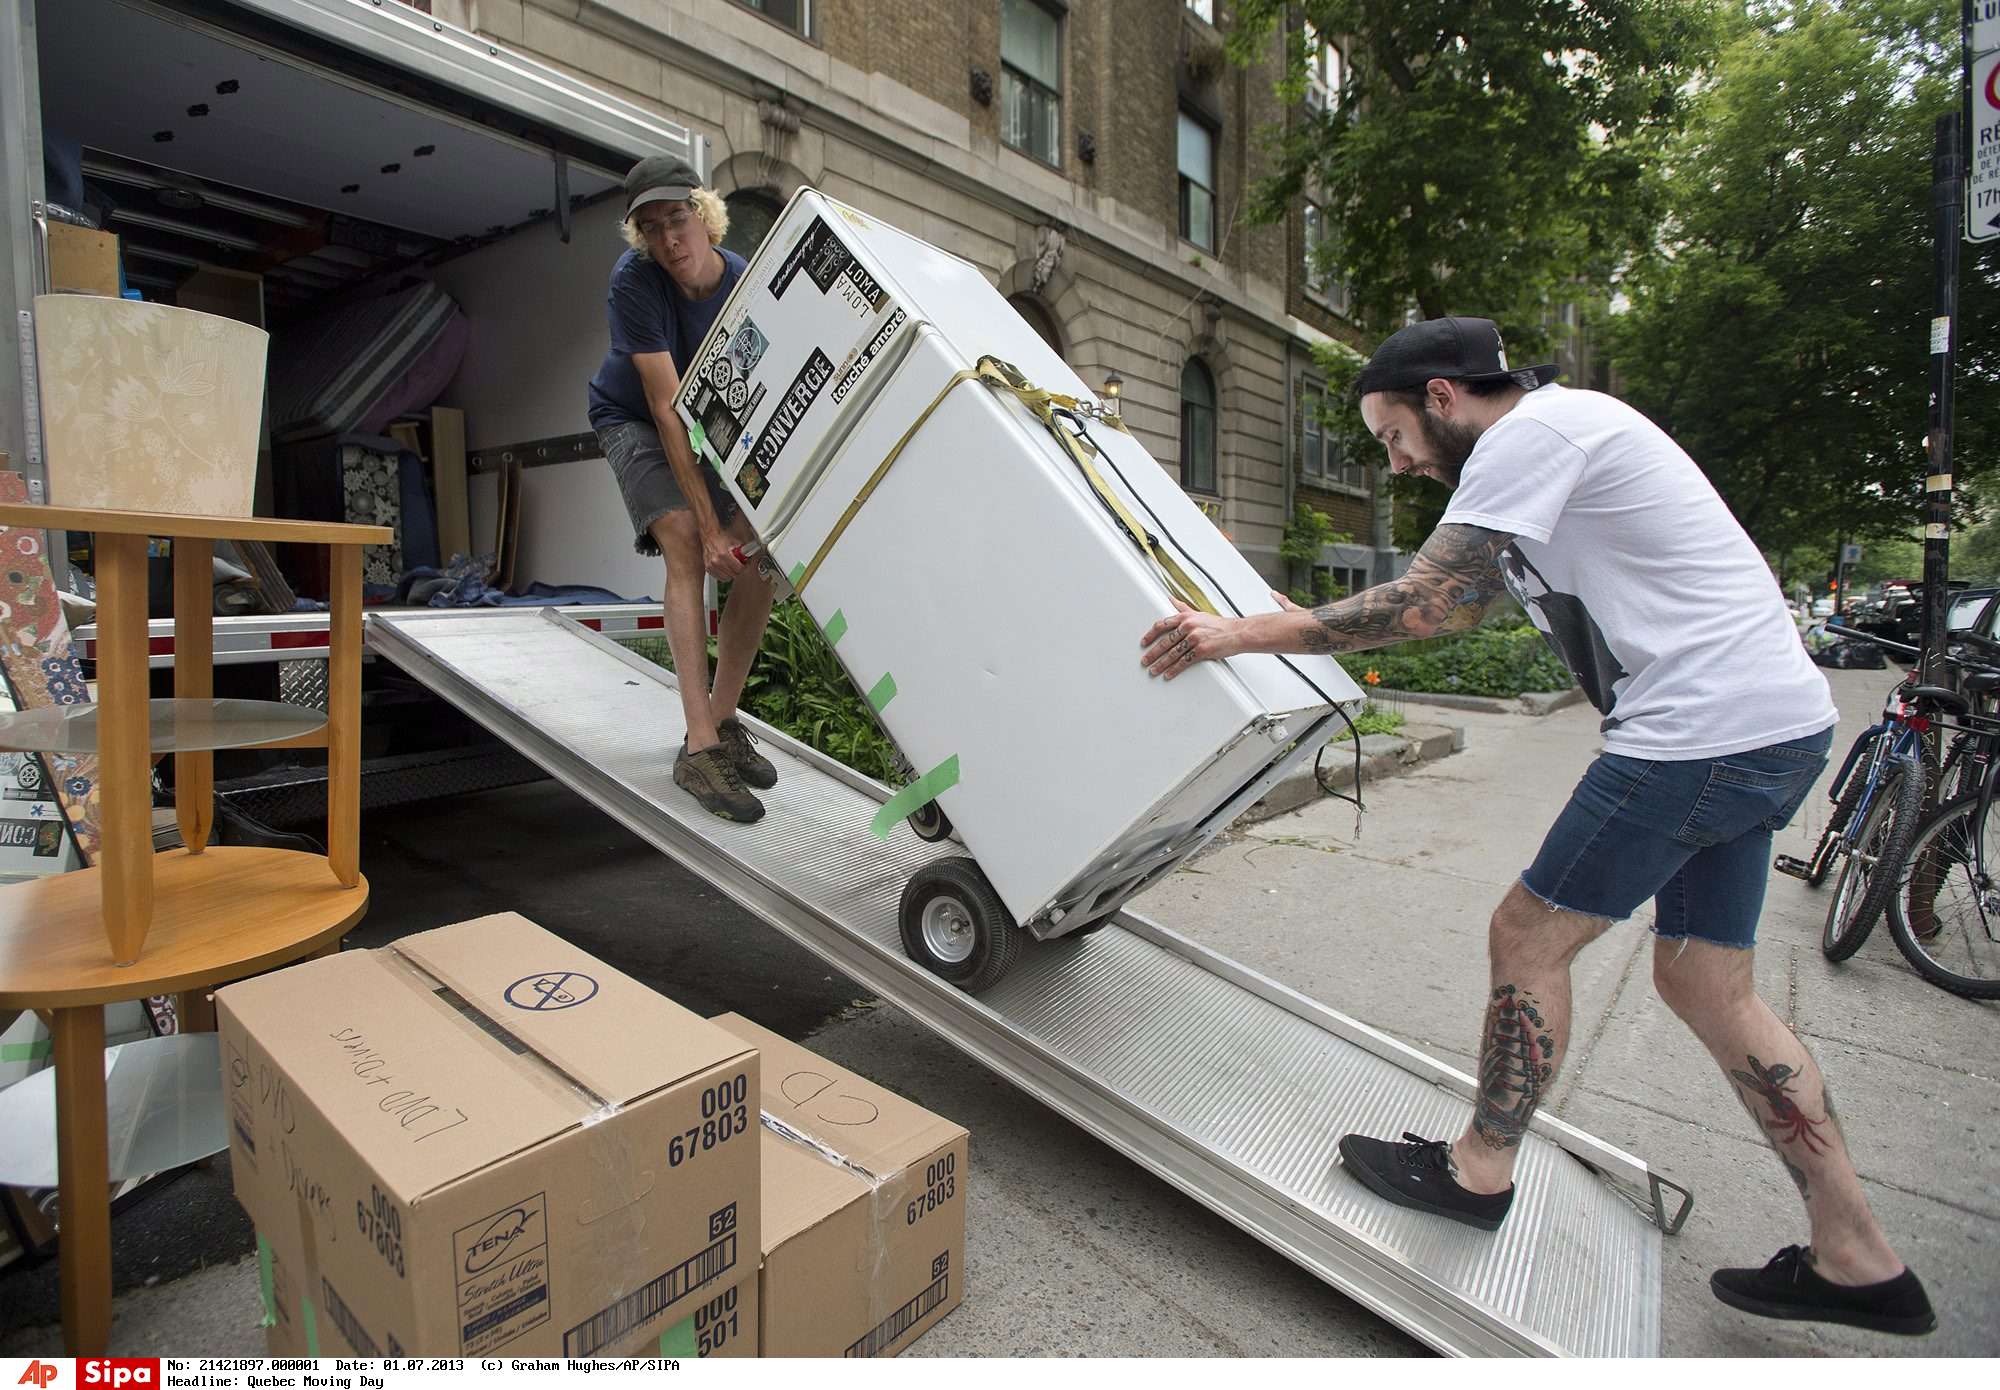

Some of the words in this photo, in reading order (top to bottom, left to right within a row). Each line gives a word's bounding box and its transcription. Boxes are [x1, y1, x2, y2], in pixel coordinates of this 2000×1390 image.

[1974, 1, 2000, 22] LU
[836, 276, 869, 318] LOMA
[845, 260, 880, 303] LOMA
[832, 353, 870, 403] touché
[869, 309, 906, 356] amoré
[756, 356, 831, 469] CONVERGE
[701, 1074, 747, 1118] 000
[780, 1071, 879, 1126] CD
[669, 1105, 747, 1167] 67803
[927, 1152, 955, 1187] 000
[371, 1183, 401, 1241] 000
[712, 1208, 735, 1235] 52
[907, 1176, 955, 1225] 67803
[356, 1200, 405, 1278] 67803
[467, 1225, 525, 1256] TENA
[933, 1254, 949, 1276] 52
[696, 1311, 738, 1358] 501
